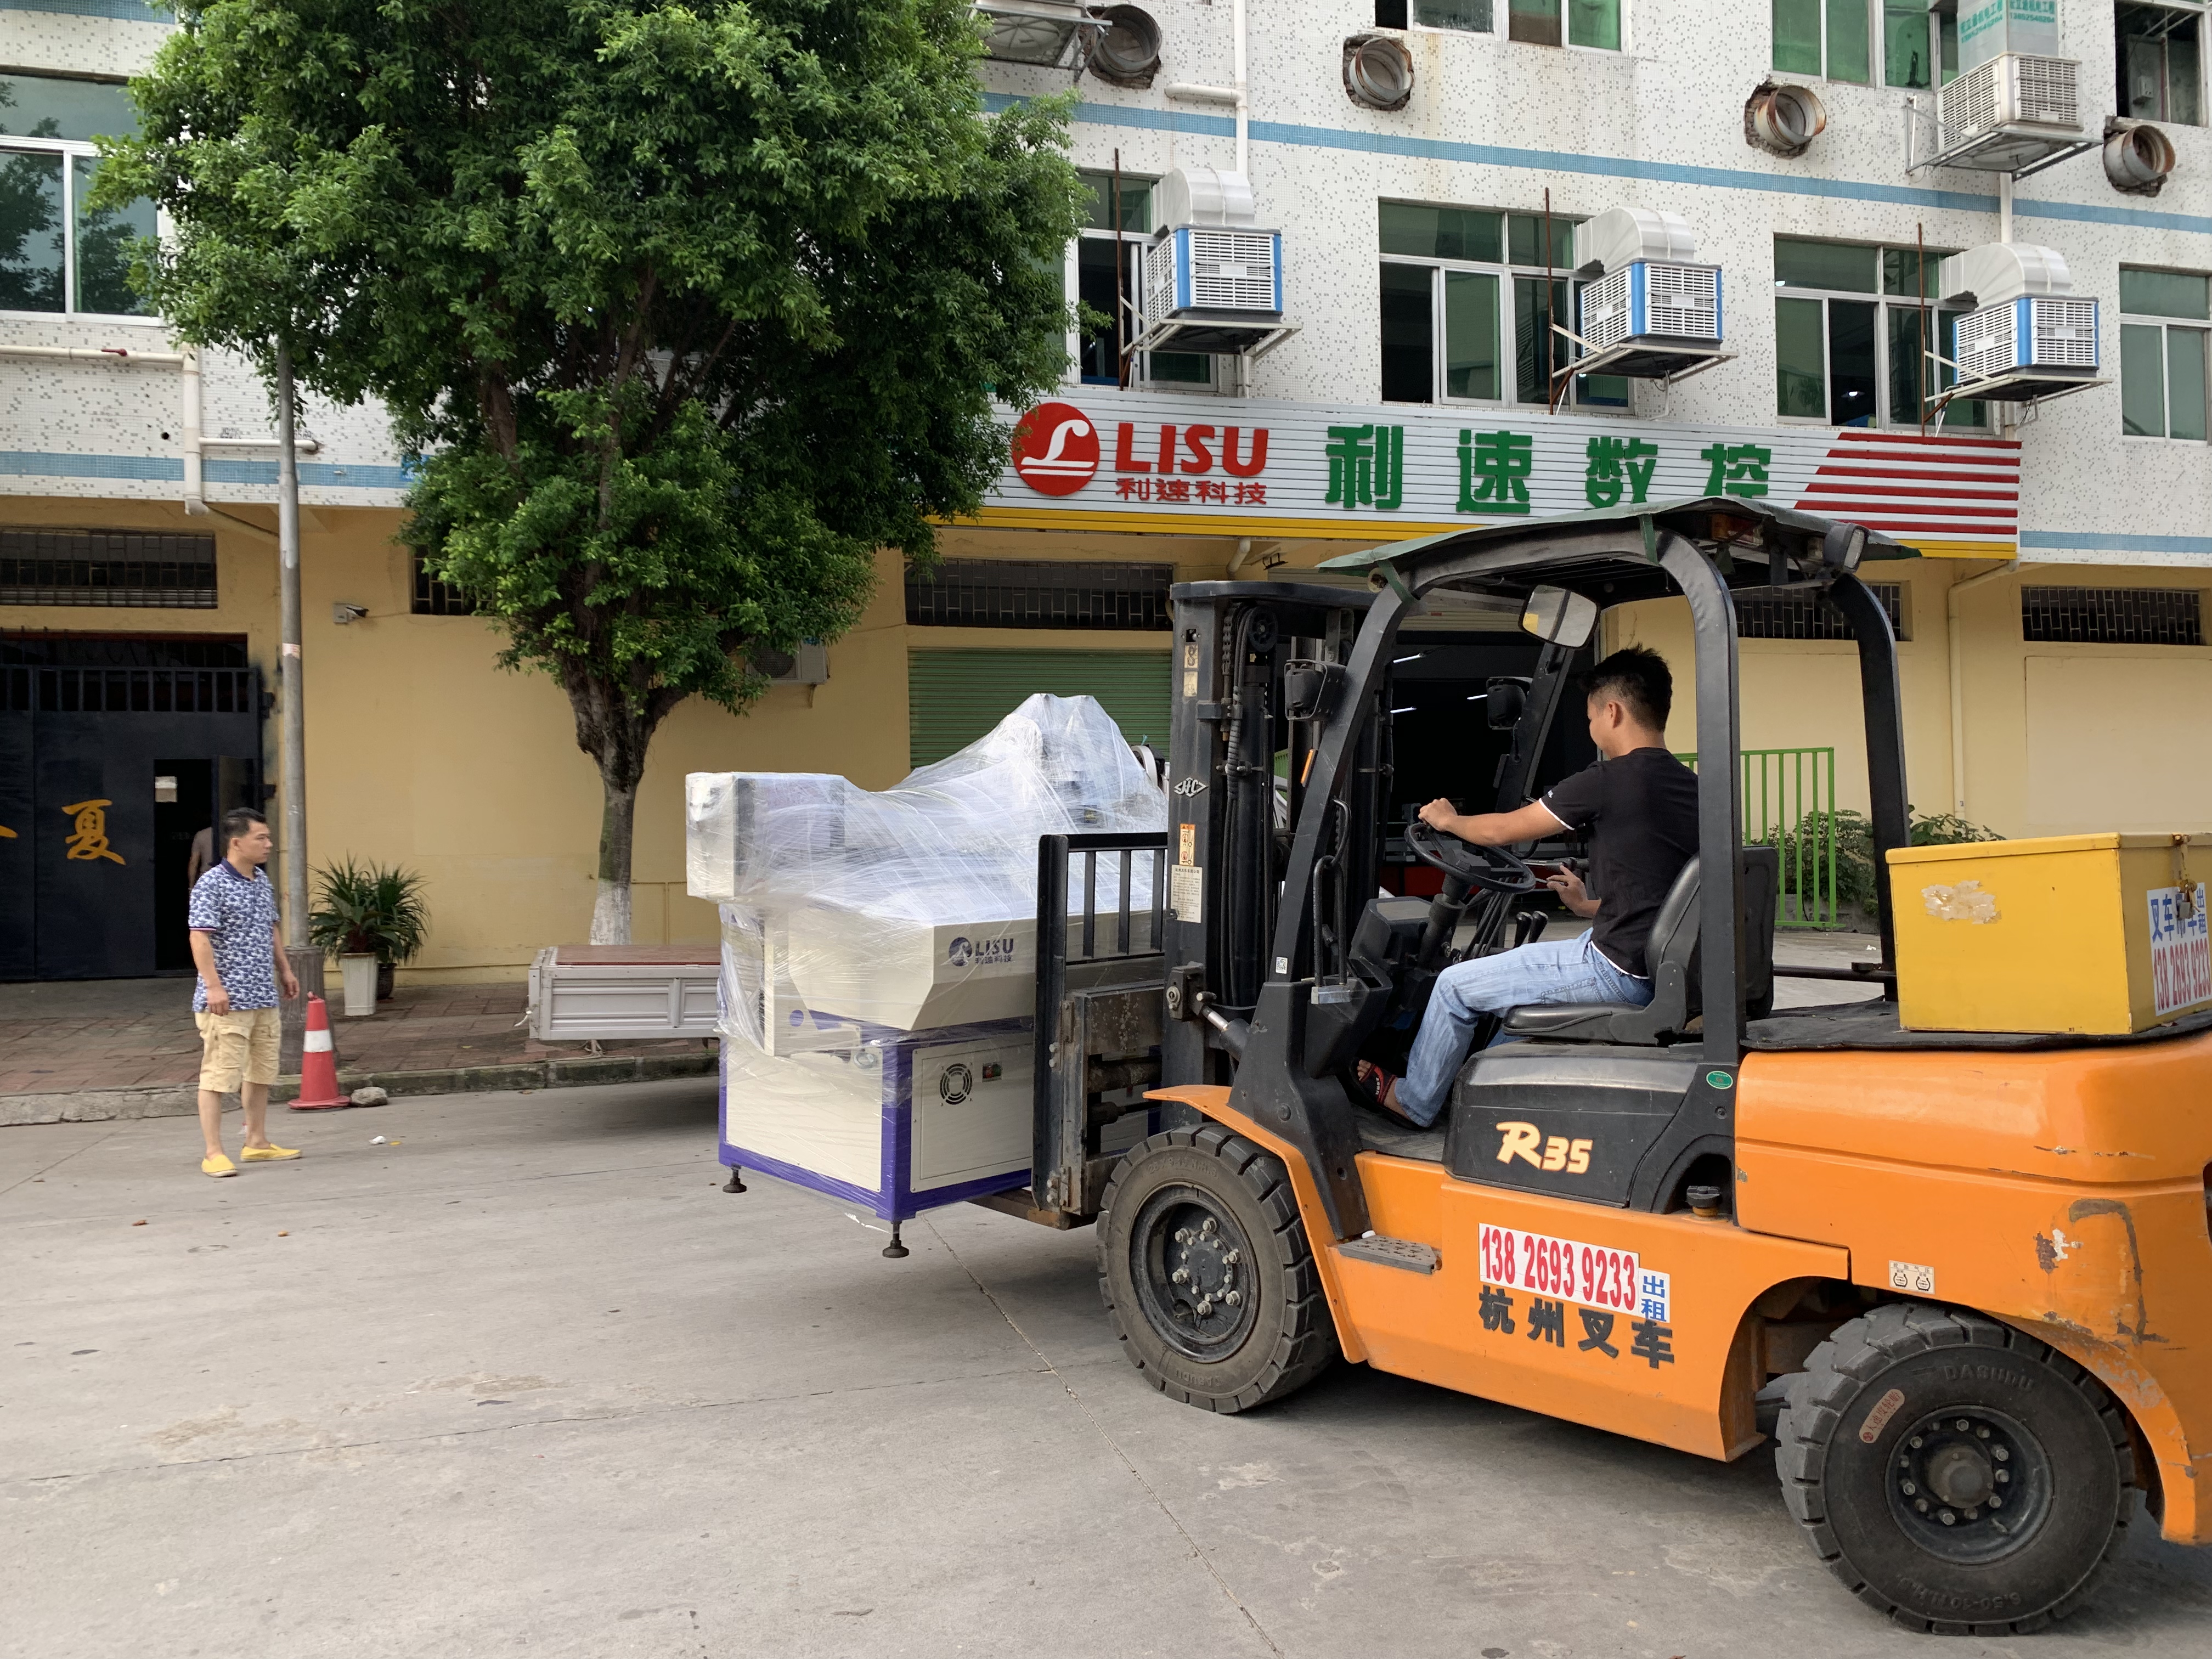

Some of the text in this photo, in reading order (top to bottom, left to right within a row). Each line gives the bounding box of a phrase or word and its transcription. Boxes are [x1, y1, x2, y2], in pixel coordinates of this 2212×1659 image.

[1115, 422, 1269, 477] LISU
[1325, 424, 1772, 514] 利速数控
[1115, 477, 1267, 505] 利速科技
[975, 938, 1014, 956] LISU
[2153, 937, 2211, 1011] 138 2693 9233
[1495, 1121, 1594, 1174] R35
[1482, 1227, 1636, 1311] 138 2693 9233
[1641, 1275, 1667, 1323] 出租
[1479, 1285, 1675, 1369] 杭州叉车
